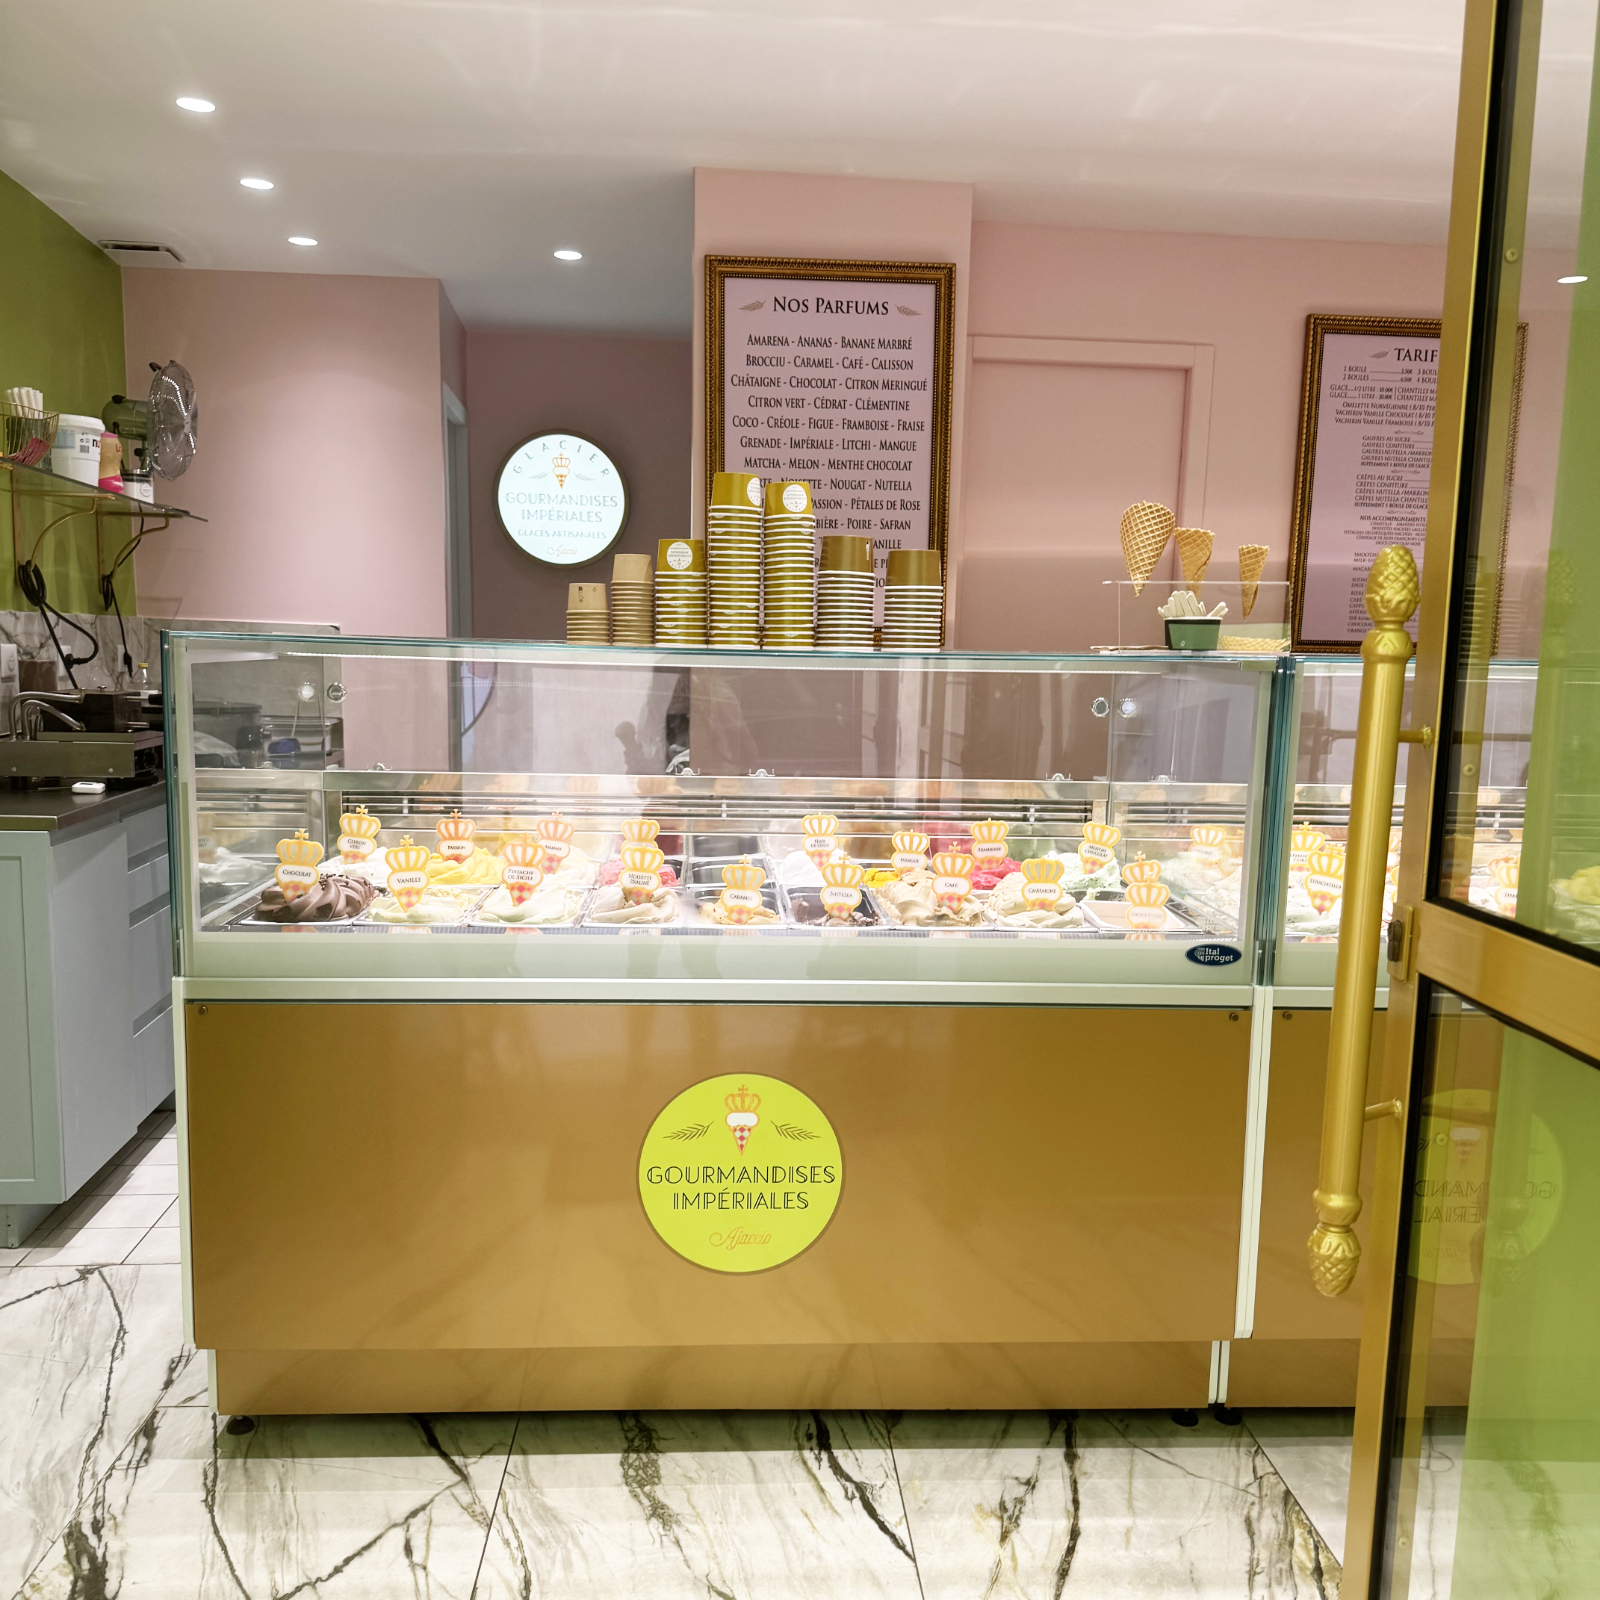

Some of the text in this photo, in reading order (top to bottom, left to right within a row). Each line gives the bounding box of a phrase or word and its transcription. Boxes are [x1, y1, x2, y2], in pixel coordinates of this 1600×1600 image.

[773, 296, 889, 315] NOS PARFUMS
[747, 334, 912, 350] AMARENA ANANAS BANANE MARBRÉ
[746, 354, 913, 370] BROCCIU CARAMEL CAFÉ CALISSON
[731, 374, 927, 391] CHÂTAIGNE CHOCOLAT CITRON MERINGUÉ
[748, 396, 909, 411] CITRON VERT CÉDRAT CLÉMENTINE
[732, 416, 925, 432] COCO CRÉOLE FIGUE FRAMBOISE FRAISE
[740, 436, 916, 452] GRENADE IMPÉRIALE LITCHI MANGUE
[744, 457, 912, 472] MATCHA MELON MENTHE CHOCOLAT
[830, 478, 866, 490] NOUGAT
[875, 479, 912, 491] NUTELLA
[506, 492, 618, 507] GOURMANDISES
[811, 498, 842, 510] ASSION
[851, 497, 883, 510] PÉTALES
[886, 499, 896, 510] DE
[900, 499, 920, 511] ROSE
[521, 507, 602, 522] IMPÉRIALES
[847, 518, 872, 530] POIRE
[880, 518, 911, 530] SAFRAN
[518, 529, 606, 539] GLACES ARTISANALES
[872, 539, 902, 550] ANILLE
[283, 870, 311, 878] CHOCOLAT
[1205, 954, 1233, 962] proget
[647, 1166, 835, 1184] GOURMANDISES
[673, 1188, 809, 1210] IMPÉRIALES
[709, 1226, 771, 1250] Ajaccio
